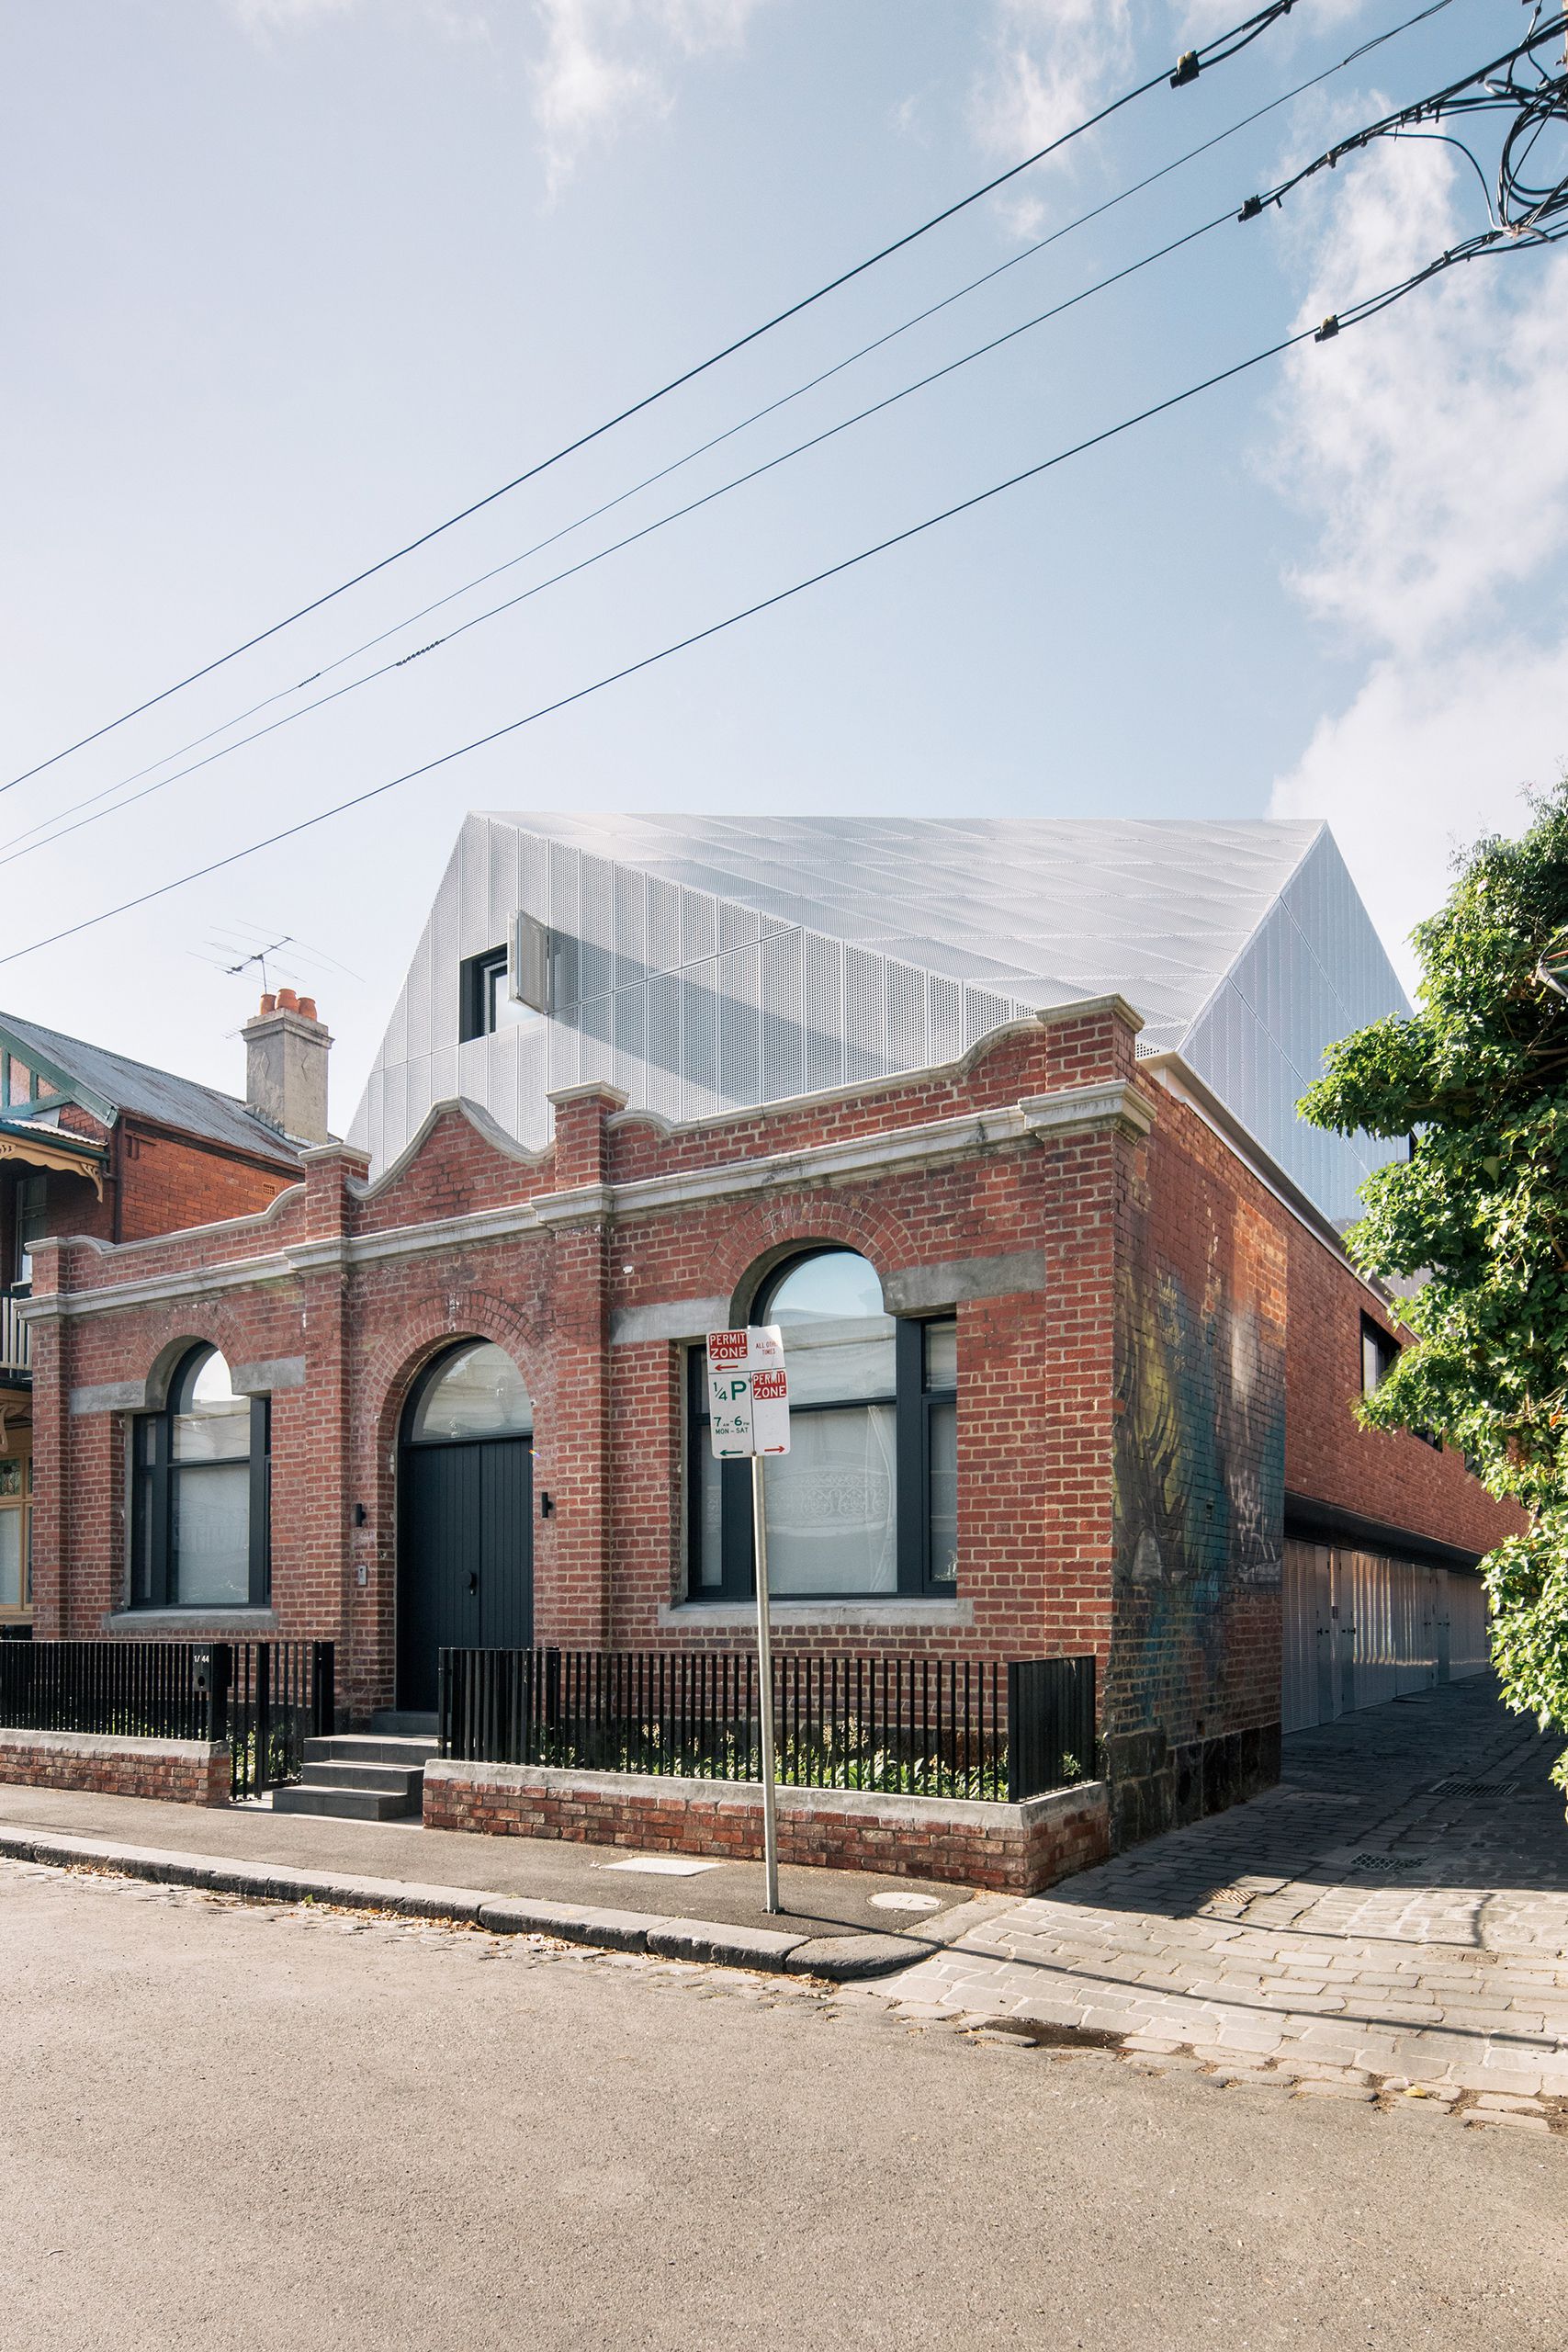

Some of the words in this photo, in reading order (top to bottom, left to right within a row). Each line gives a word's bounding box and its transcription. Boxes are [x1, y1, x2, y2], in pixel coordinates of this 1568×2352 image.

[710, 1333, 746, 1346] PERMIT
[711, 1346, 747, 1359] ZONE
[753, 1372, 784, 1385] PERMIT
[754, 1385, 785, 1398] ZONE
